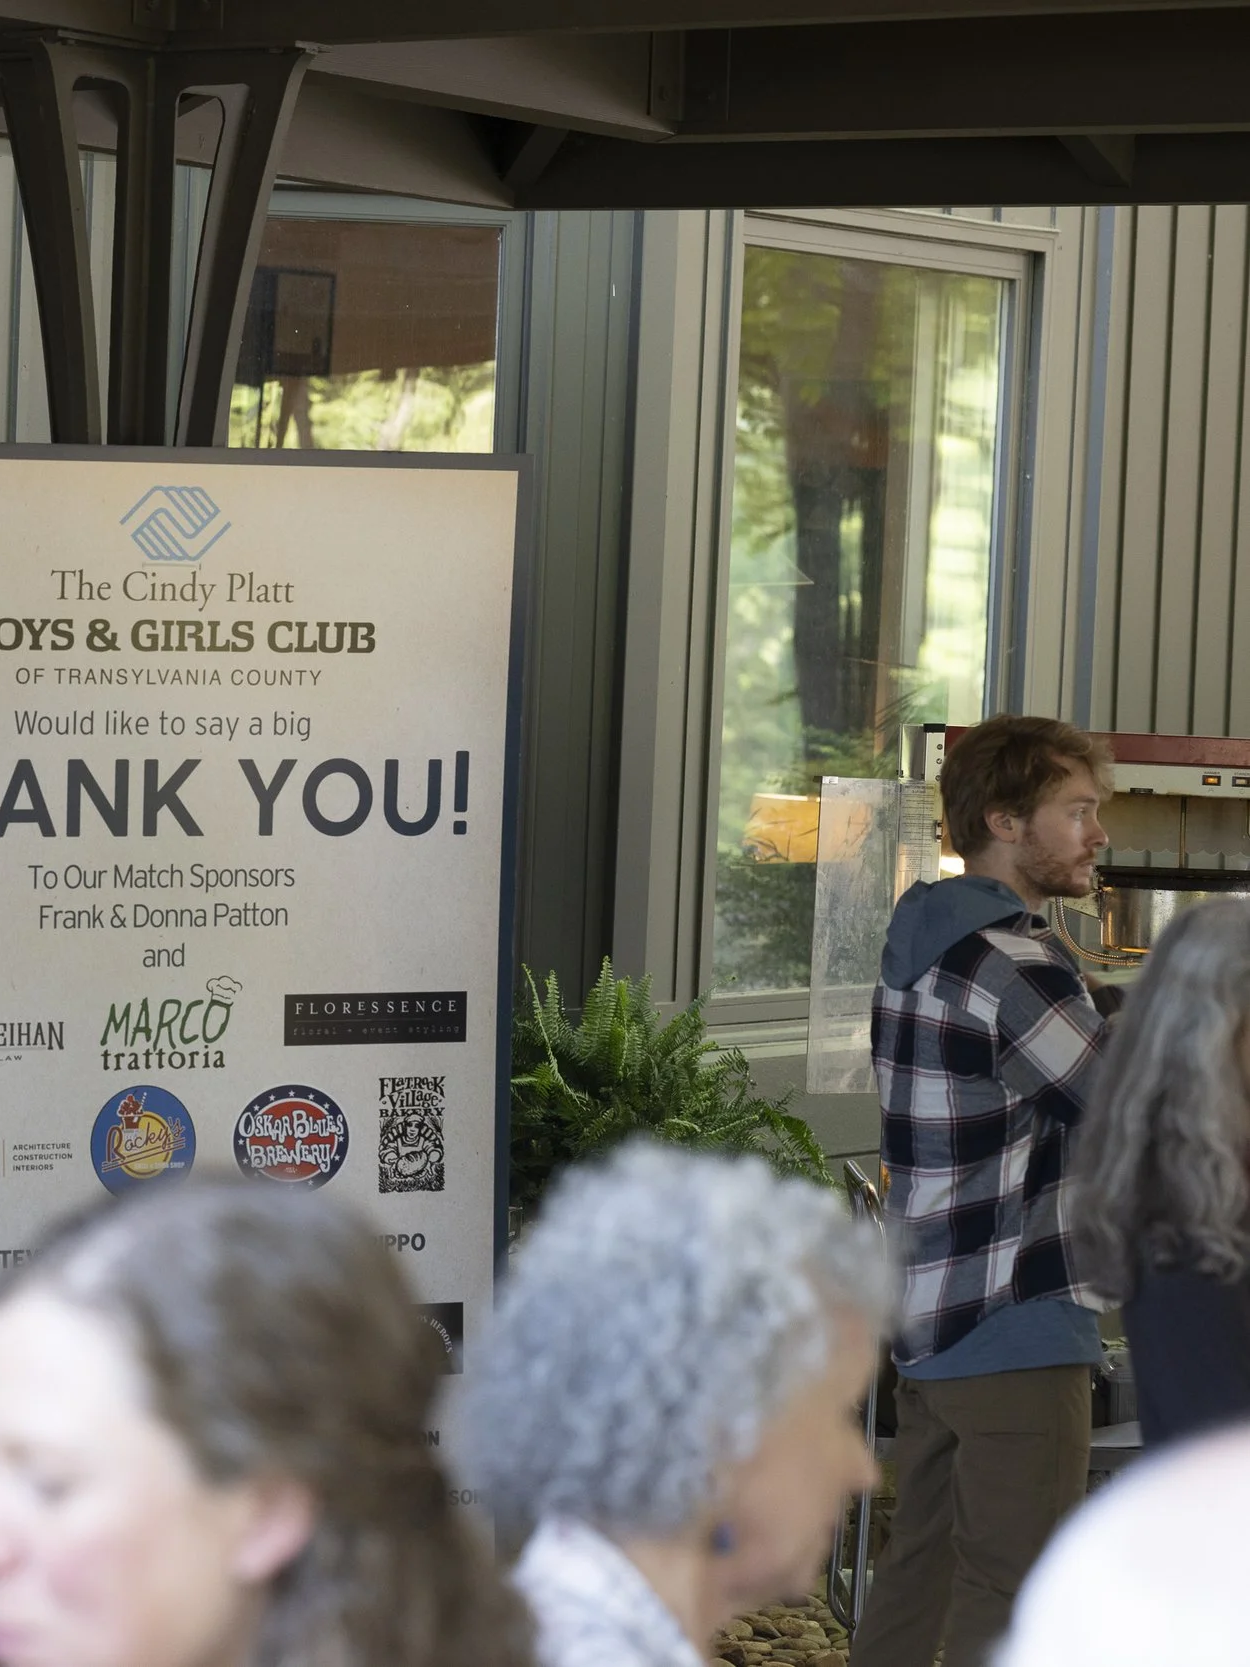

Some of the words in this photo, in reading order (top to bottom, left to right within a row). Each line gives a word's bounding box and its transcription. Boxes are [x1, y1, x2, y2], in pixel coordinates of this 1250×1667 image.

[51, 569, 112, 601] The
[122, 570, 217, 612] Cindy
[227, 572, 295, 603] Platt
[86, 619, 121, 652] &
[131, 619, 255, 652] GIRLS
[267, 621, 376, 653] CLUB
[15, 668, 45, 684] OF
[54, 668, 222, 686] TRANSYLVANIA
[231, 669, 322, 686] COUNTY
[14, 710, 94, 735] Would
[105, 710, 150, 735] like
[159, 710, 185, 736] to
[195, 716, 239, 741] say
[249, 717, 263, 736] a
[273, 711, 311, 741] big
[238, 751, 469, 837] YOU!
[28, 865, 58, 889] To
[64, 865, 107, 889] Our
[113, 864, 183, 888] Match
[190, 864, 295, 893] Sponsors
[40, 904, 104, 929] Frank
[110, 904, 127, 928] &
[133, 904, 207, 927] Donna
[214, 902, 288, 927] Patton
[142, 943, 185, 968] and
[295, 1000, 457, 1015] FLORESSENCE
[100, 997, 234, 1051] MARCO
[101, 1045, 225, 1071] trattoria
[379, 1107, 445, 1117] BAKERY
[13, 1153, 73, 1161] CONSTRUCTION
